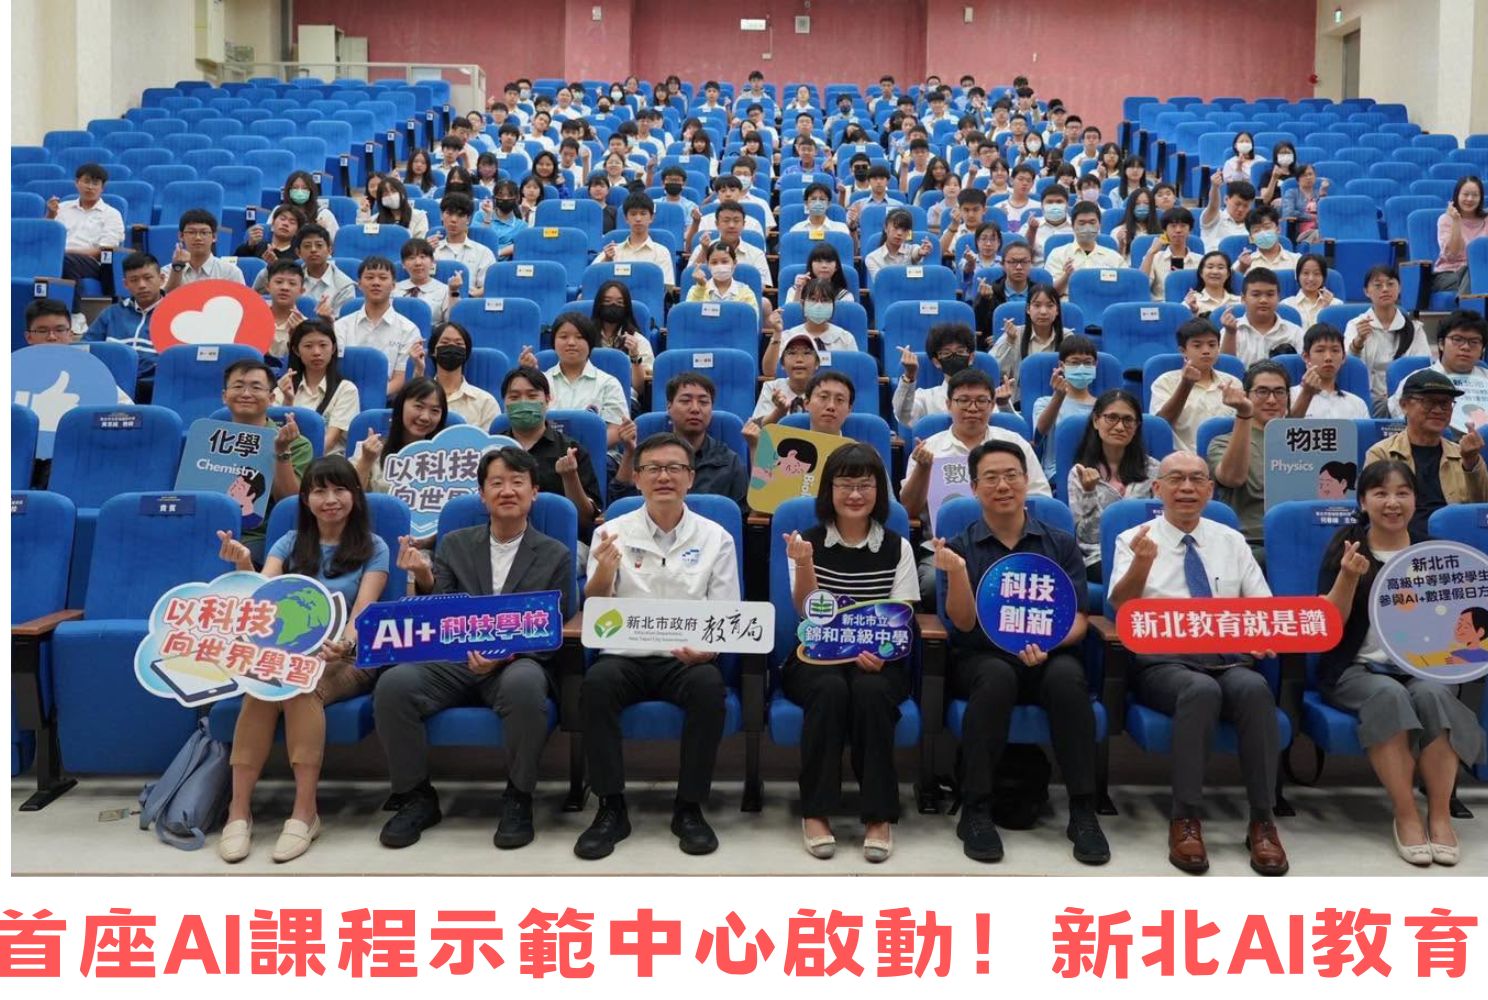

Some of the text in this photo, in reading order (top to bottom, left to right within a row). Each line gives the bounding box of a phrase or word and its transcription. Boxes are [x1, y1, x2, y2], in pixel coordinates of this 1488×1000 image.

[209, 429, 261, 457] 化學
[1285, 427, 1338, 452] 物理
[196, 458, 260, 481] Chemistry
[388, 451, 478, 482] 以科技
[1270, 459, 1314, 473] Physics
[1412, 554, 1461, 573] 新北市
[1000, 571, 1056, 603] 科技
[165, 598, 277, 637] 以科技
[841, 613, 889, 627] 新北市立
[998, 604, 1054, 636] 創新
[1130, 608, 1329, 640] 新北教育就是讚
[805, 626, 909, 646] 錦和高級中學
[163, 631, 318, 686] 向世界學習
